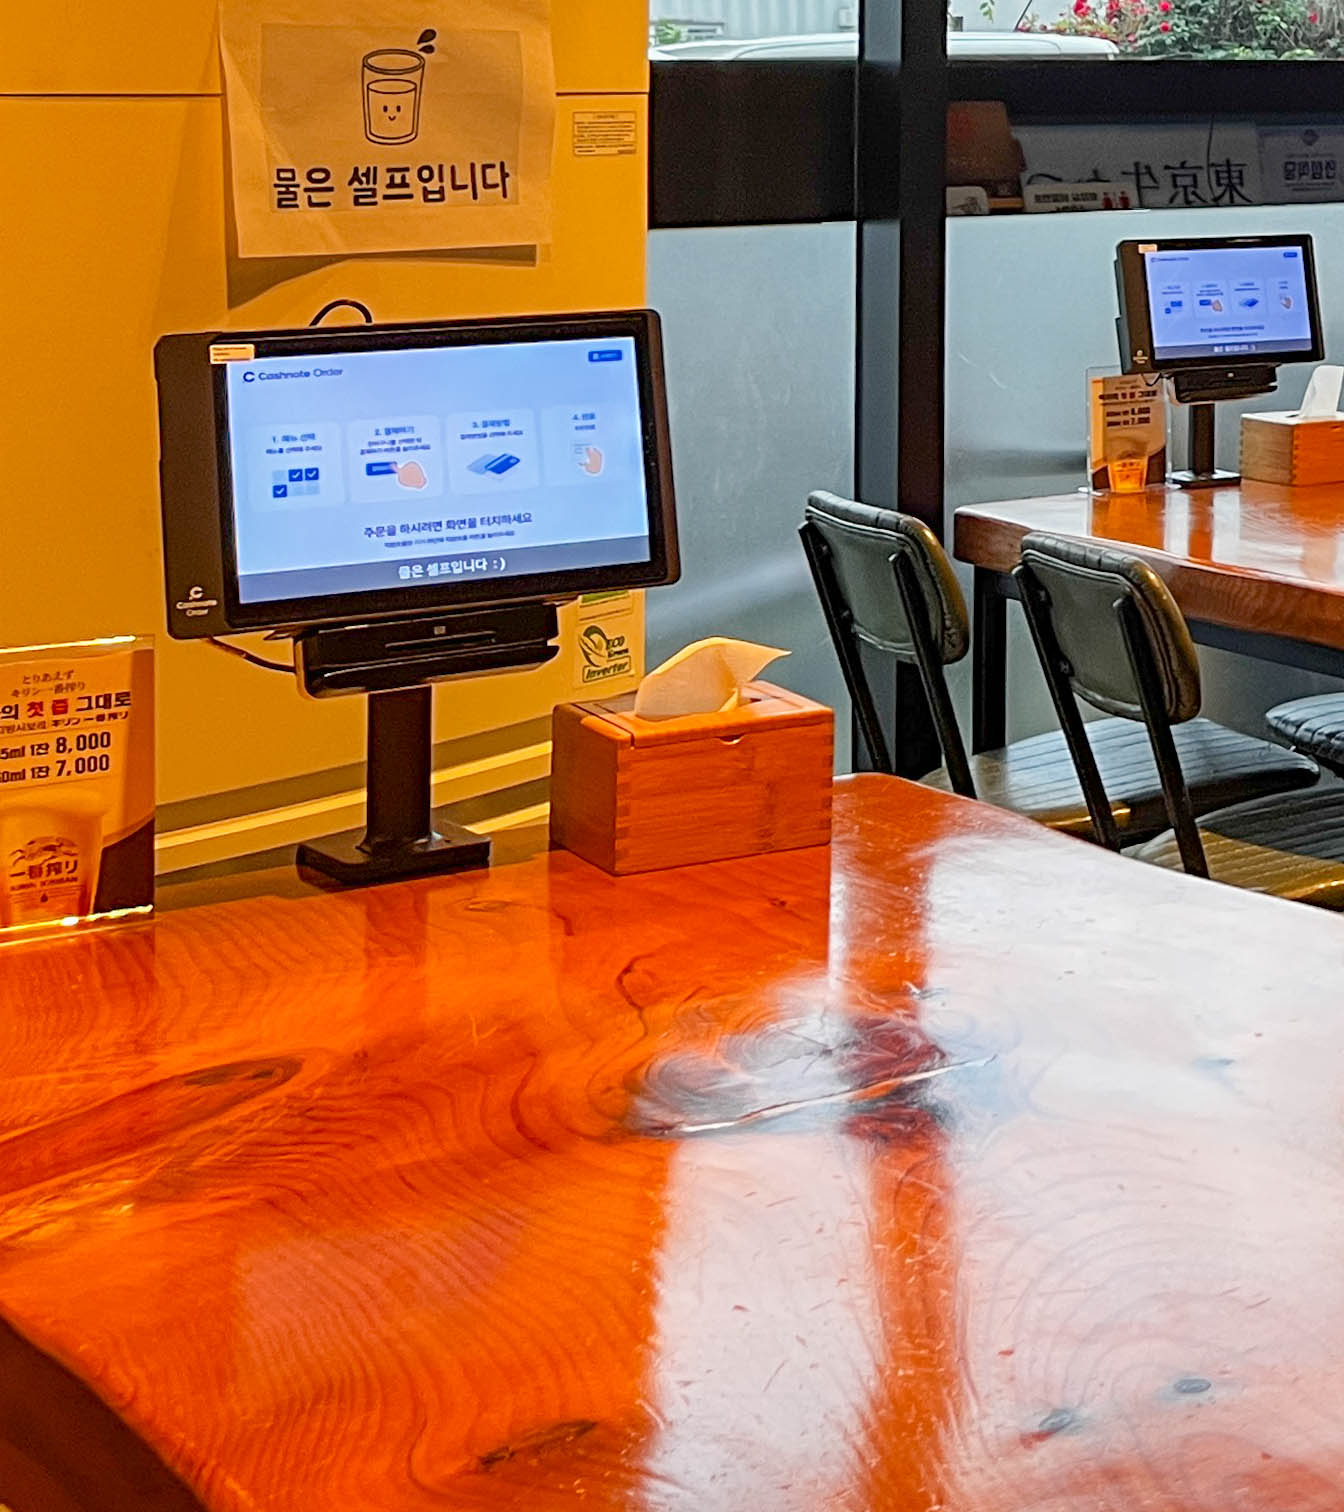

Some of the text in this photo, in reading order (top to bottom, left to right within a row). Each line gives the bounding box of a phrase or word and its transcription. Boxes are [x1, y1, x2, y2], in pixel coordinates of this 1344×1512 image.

[273, 161, 511, 210] 물은 셀프입니다
[258, 370, 310, 381] Cashnote
[313, 367, 344, 378] Order
[364, 524, 396, 539] 주문을
[400, 521, 442, 534] 하시려면
[446, 518, 477, 530] 화면을
[480, 512, 533, 528] 터치하세요
[398, 565, 424, 579] 물은
[426, 558, 488, 577] 셀프입니다
[23, 670, 74, 685] とりあえず
[586, 661, 628, 680] Inverter
[0, 704, 19, 720] 의
[27, 701, 44, 718] 첫
[76, 691, 132, 711] 그대로
[56, 732, 111, 753] 8,000
[56, 754, 110, 777] 7,000
